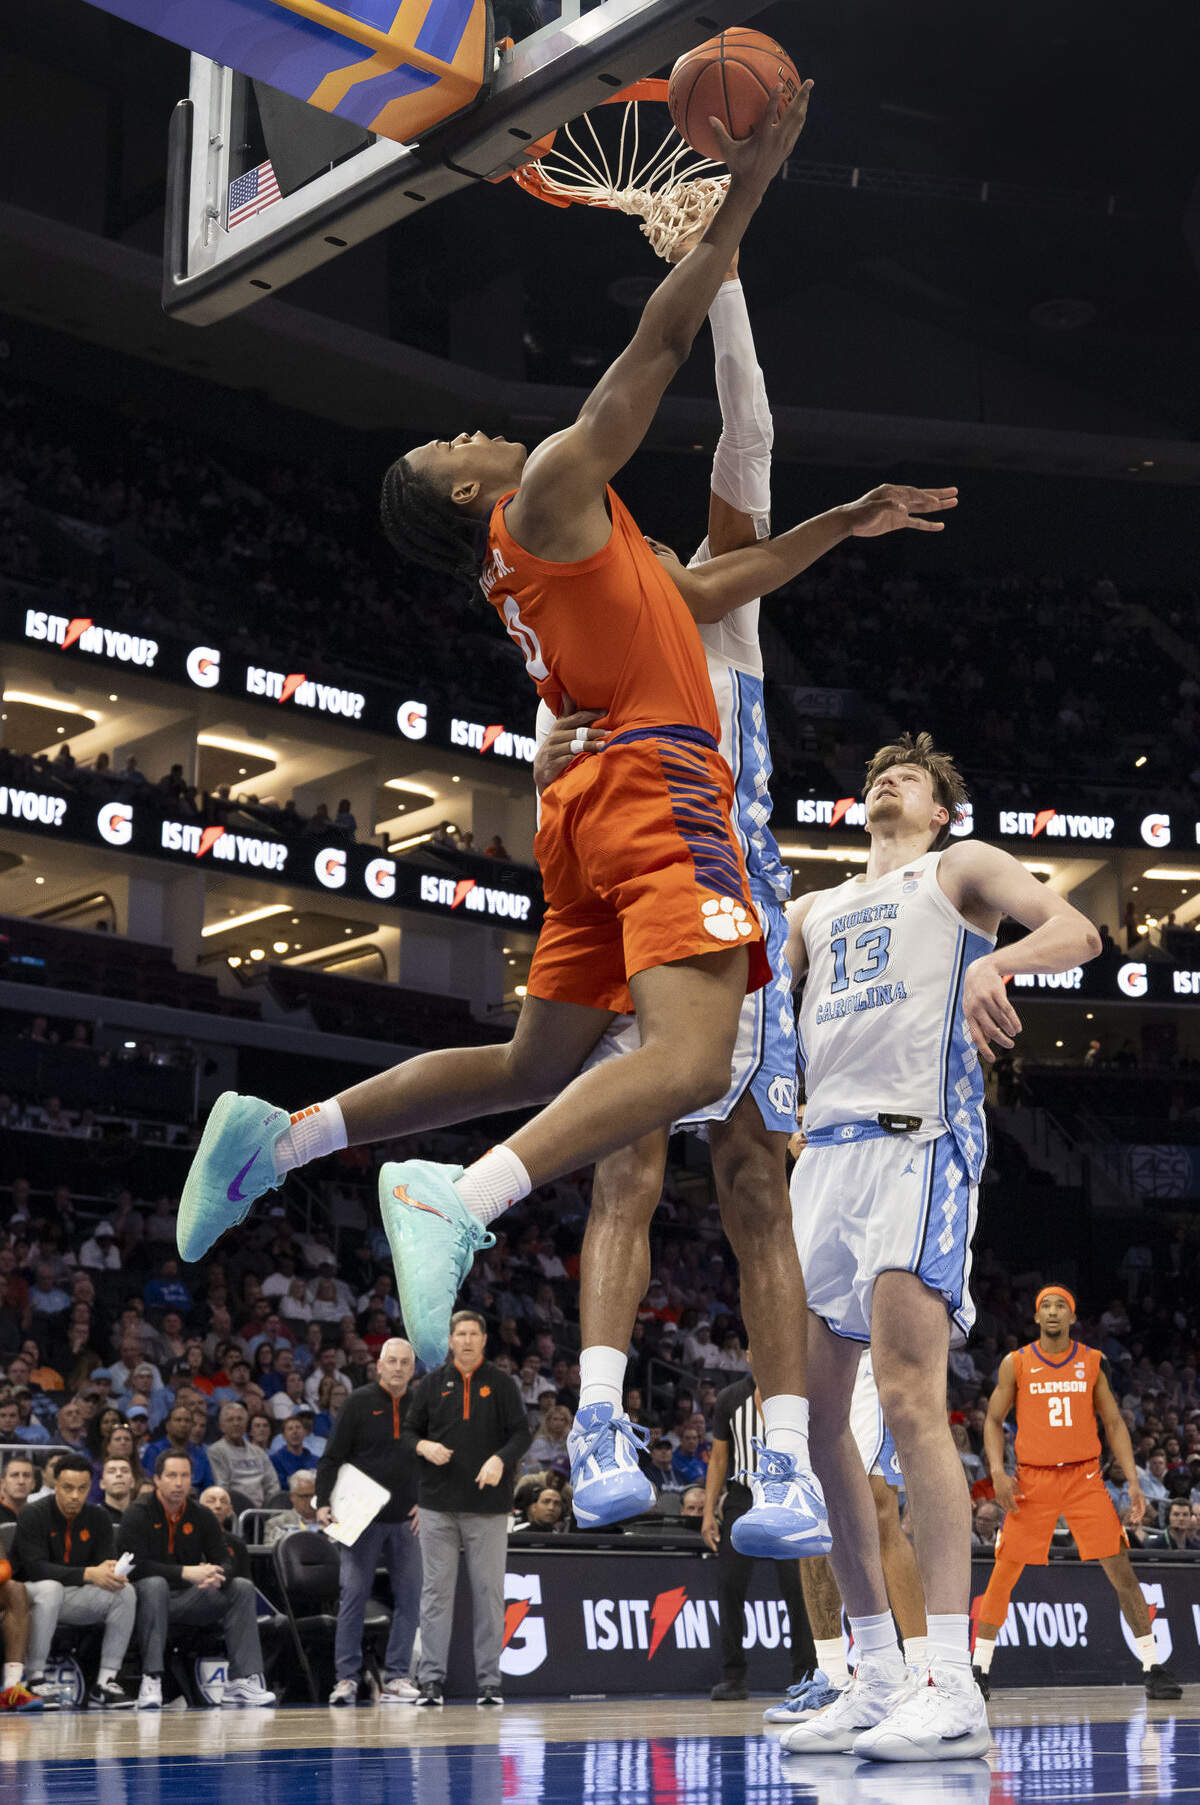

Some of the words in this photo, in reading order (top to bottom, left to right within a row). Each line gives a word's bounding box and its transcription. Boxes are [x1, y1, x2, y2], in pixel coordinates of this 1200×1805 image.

[103, 629, 158, 667] YOU?
[187, 646, 220, 688] G
[315, 684, 365, 719] YOU?
[397, 701, 427, 740] G
[8, 788, 67, 826] YOU?
[98, 802, 133, 845] G
[1067, 815, 1114, 839] YOU?
[1140, 814, 1171, 848] G
[235, 836, 288, 871] YOU?
[315, 848, 346, 888] G
[365, 858, 396, 898] G
[486, 889, 530, 920] YOU?
[830, 904, 899, 937] NORTH
[830, 925, 891, 994] 13
[1117, 962, 1148, 997] G
[815, 980, 907, 1025] CAROLINA
[1029, 1381, 1087, 1395] CLEMSON
[1048, 1396, 1073, 1427] 21
[1016, 1602, 1089, 1648] YOU?
